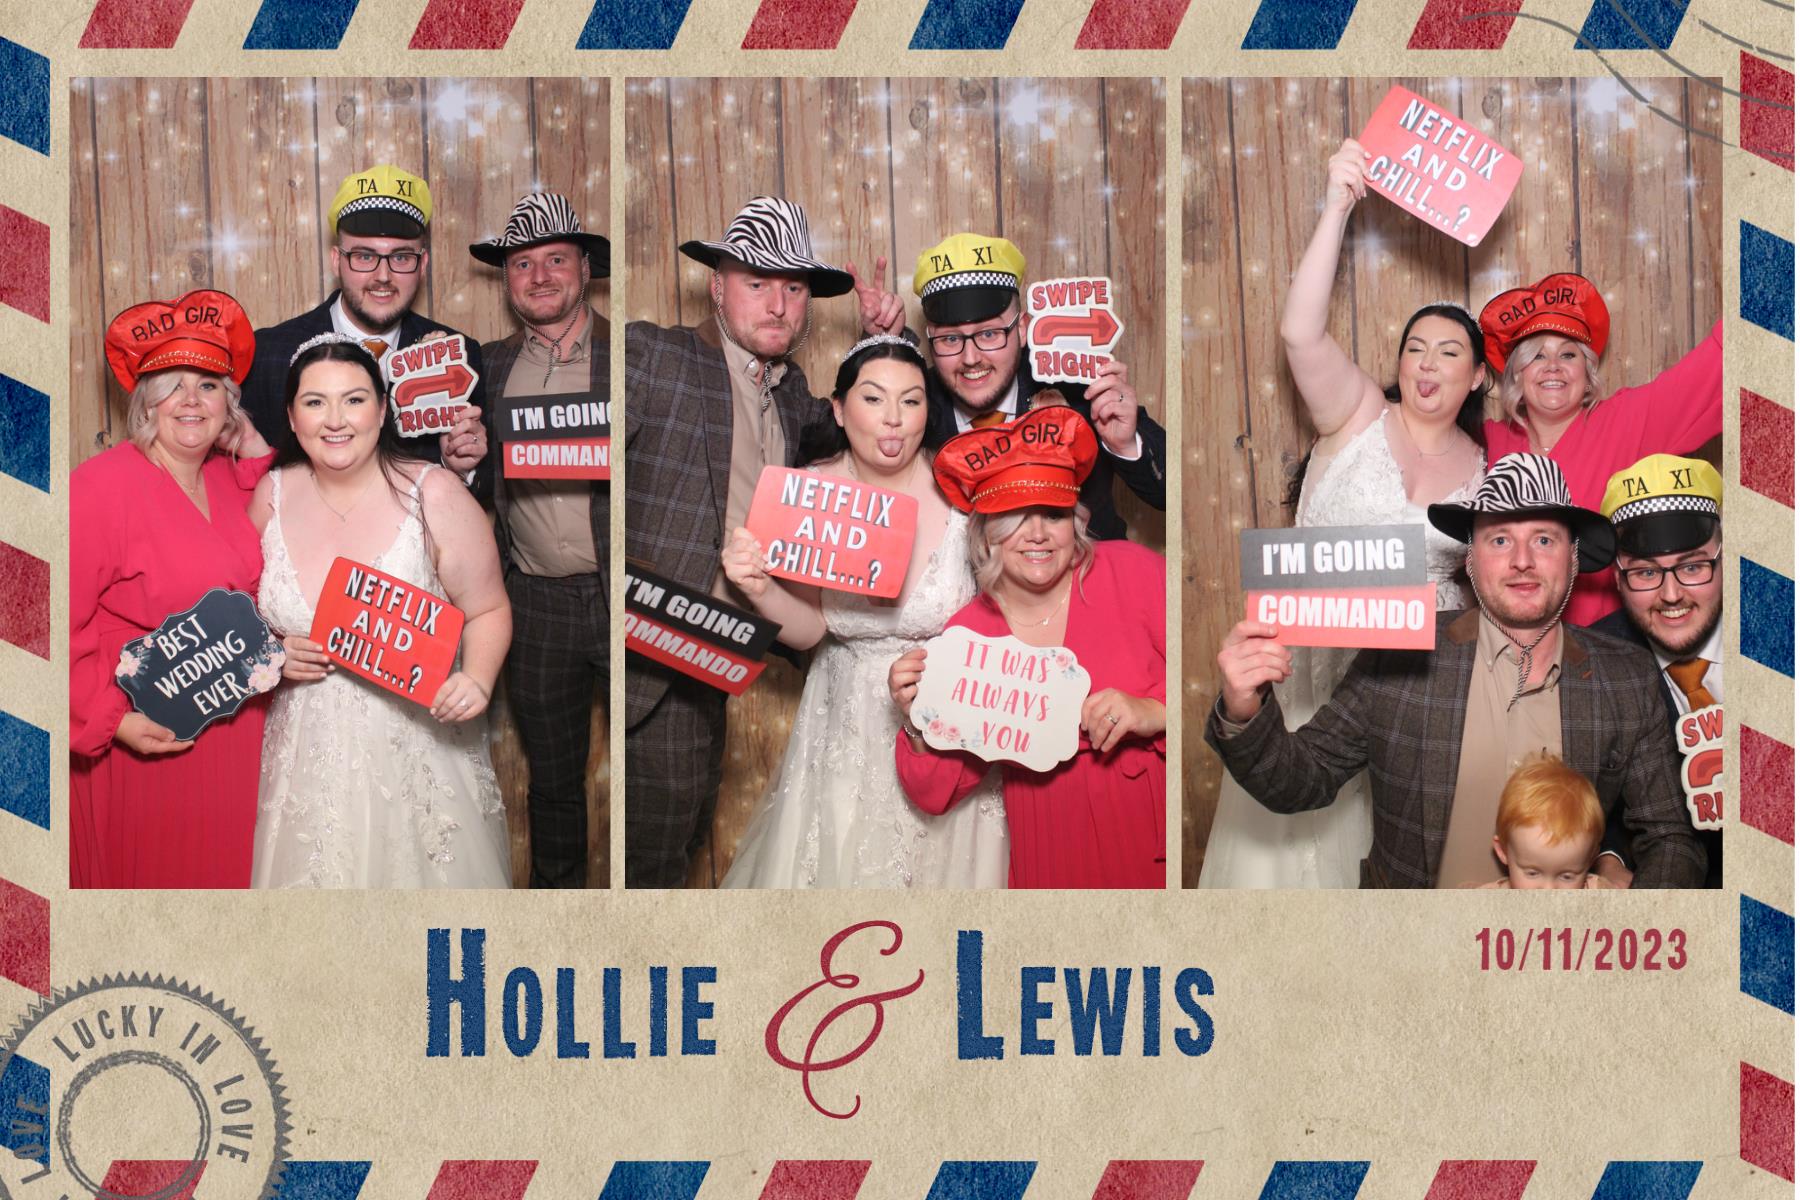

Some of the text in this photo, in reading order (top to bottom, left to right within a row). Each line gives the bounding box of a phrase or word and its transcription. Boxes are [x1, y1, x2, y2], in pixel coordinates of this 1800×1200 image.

[1399, 98, 1503, 181] NETFLIX
[1401, 143, 1467, 192] AND
[1032, 280, 1109, 310] SWIPE
[1499, 287, 1577, 326] BAD GIRL
[131, 306, 223, 341] BAD GIRL
[391, 338, 462, 378] SWIPE
[511, 406, 545, 431] I'M
[511, 444, 609, 467] COMMAN
[964, 422, 1065, 472] BAD GIRL
[780, 472, 895, 528] NETFLIX
[794, 515, 867, 550] AND
[1262, 538, 1405, 576] I'M GOING
[344, 566, 443, 636] NETFLIX
[665, 594, 756, 645] GOING
[1258, 594, 1425, 631] COMMANDO
[155, 613, 208, 661] BEST
[351, 610, 413, 652] AND
[625, 612, 749, 683] OMMANDO
[154, 630, 247, 700] WEDDING
[963, 640, 1052, 684] IT WAS
[193, 671, 248, 715] EVER
[951, 677, 1052, 722] ALWAYS
[982, 720, 1031, 753] YOU
